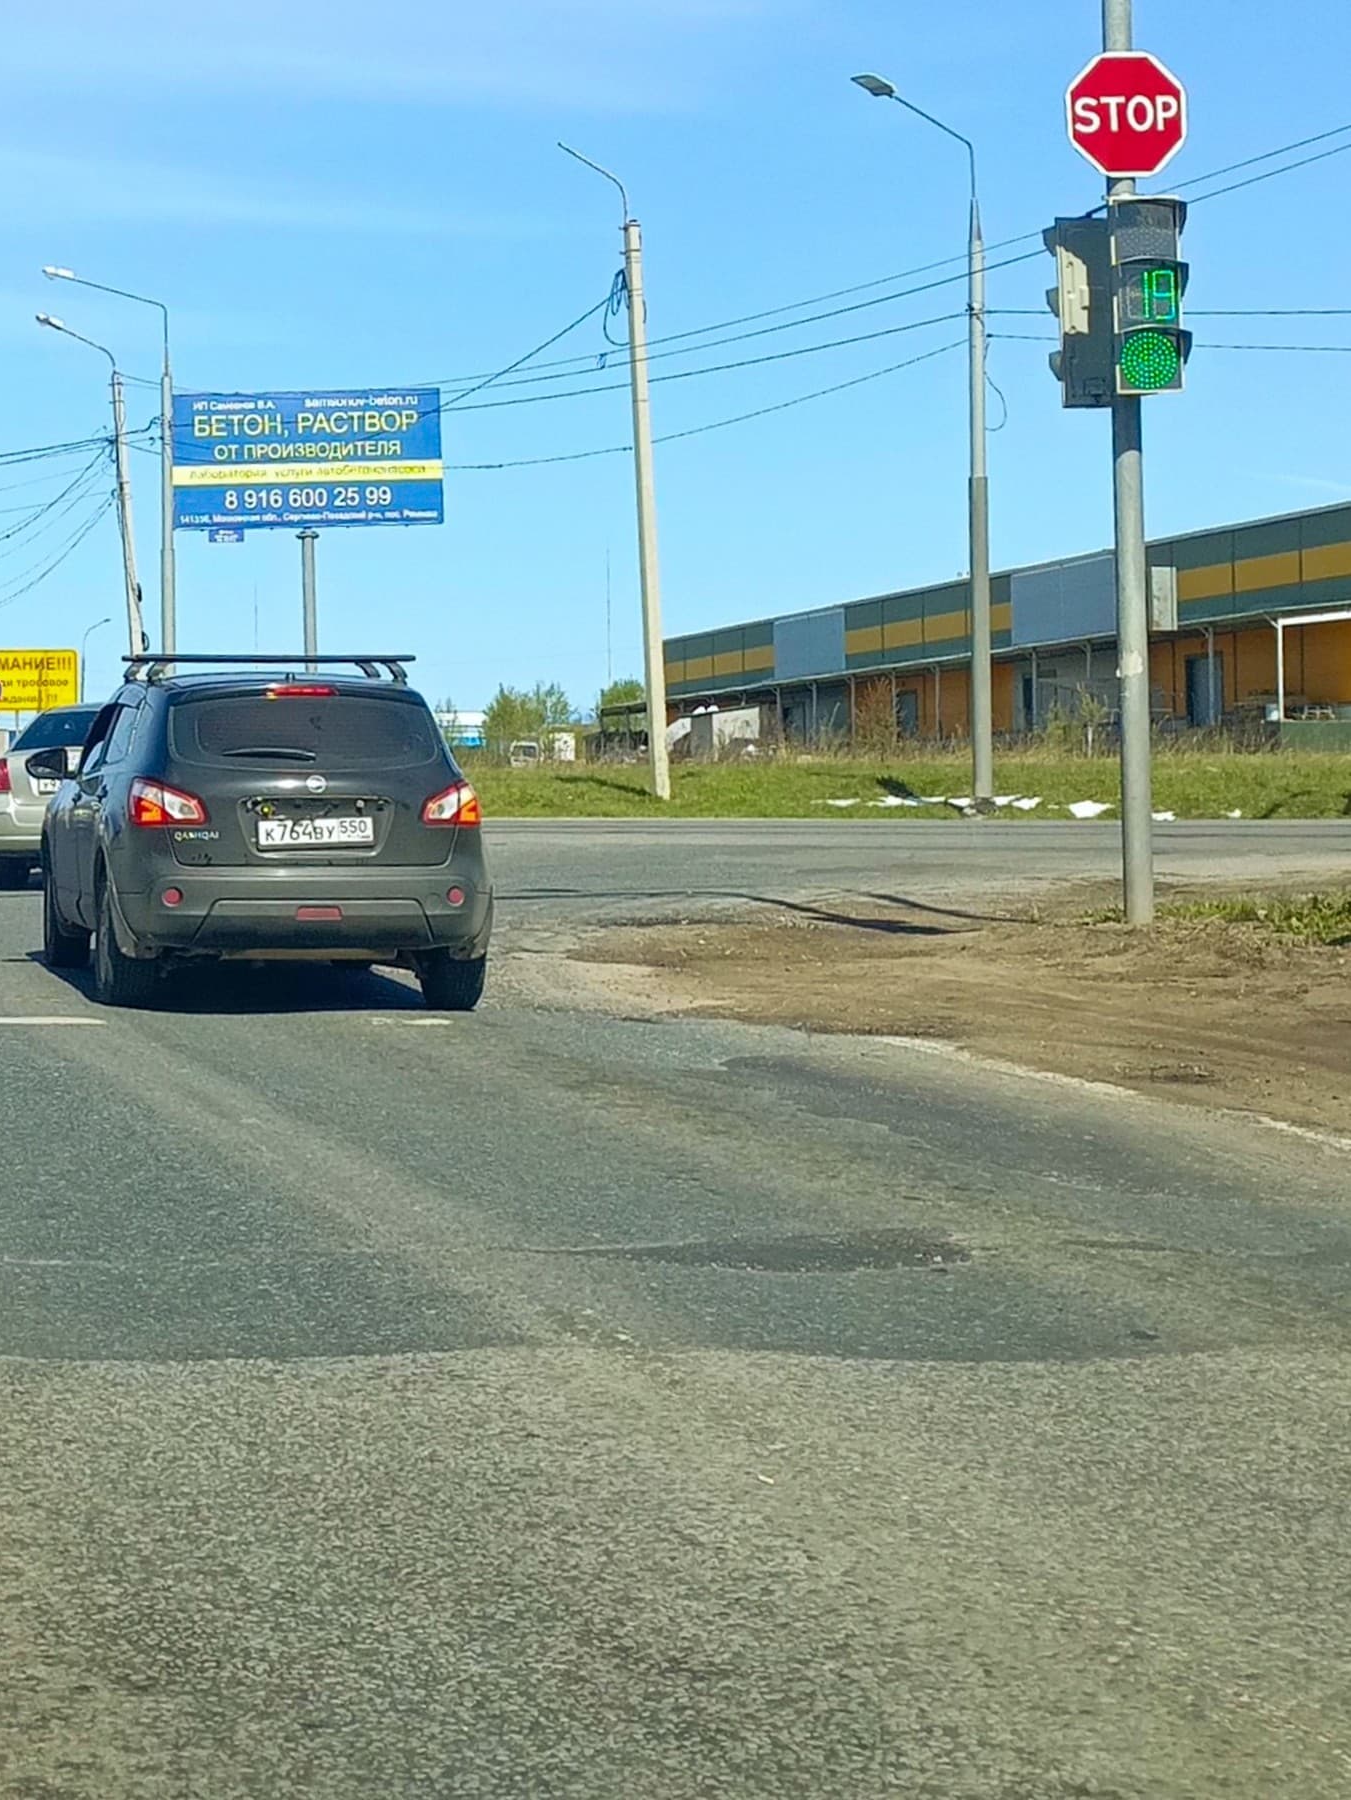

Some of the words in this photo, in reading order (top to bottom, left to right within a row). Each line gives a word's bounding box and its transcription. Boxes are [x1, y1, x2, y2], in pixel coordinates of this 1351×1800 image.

[1074, 94, 1179, 133] STOP
[1144, 270, 1176, 320] 19
[194, 413, 290, 438] БЕТОН,
[297, 410, 419, 434] РАСТВОР
[214, 445, 239, 460] ОТ
[244, 440, 401, 461] ПРОИЗВОДИТЕЛЯ
[225, 490, 238, 510] 8
[244, 489, 283, 509] 916
[289, 487, 328, 508] 600
[333, 486, 361, 507] 25
[365, 485, 392, 506] 99
[339, 819, 368, 834] 550
